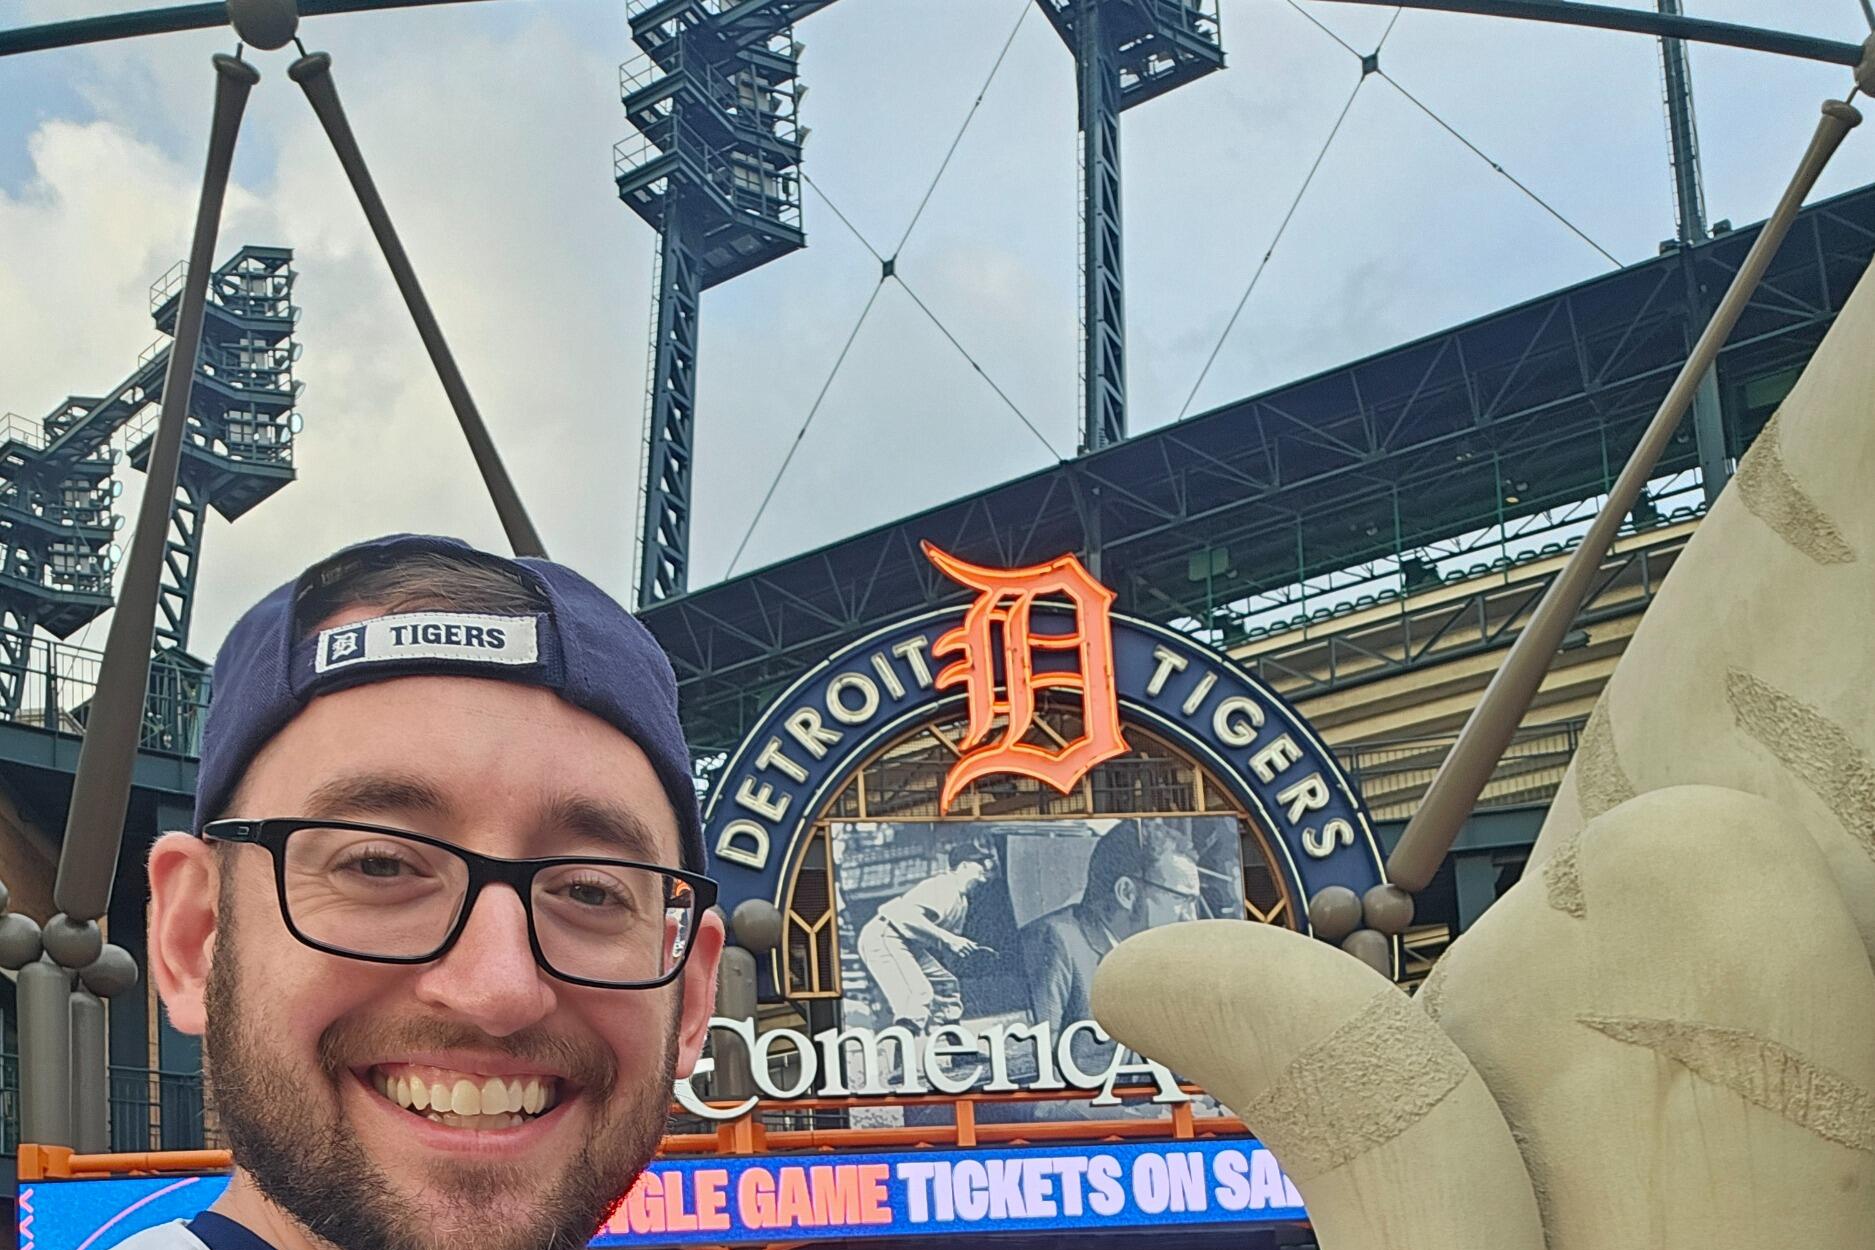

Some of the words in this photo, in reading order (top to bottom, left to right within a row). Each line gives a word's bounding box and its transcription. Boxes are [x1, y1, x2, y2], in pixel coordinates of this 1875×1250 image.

[390, 624, 506, 649] TIGERS
[920, 539, 1132, 816] D
[715, 636, 936, 870] DETROIT
[1147, 645, 1354, 858] TIGERS
[738, 1164, 892, 1229] GAME
[897, 1154, 1124, 1223] TICKETS
[1132, 1152, 1207, 1214] ON
